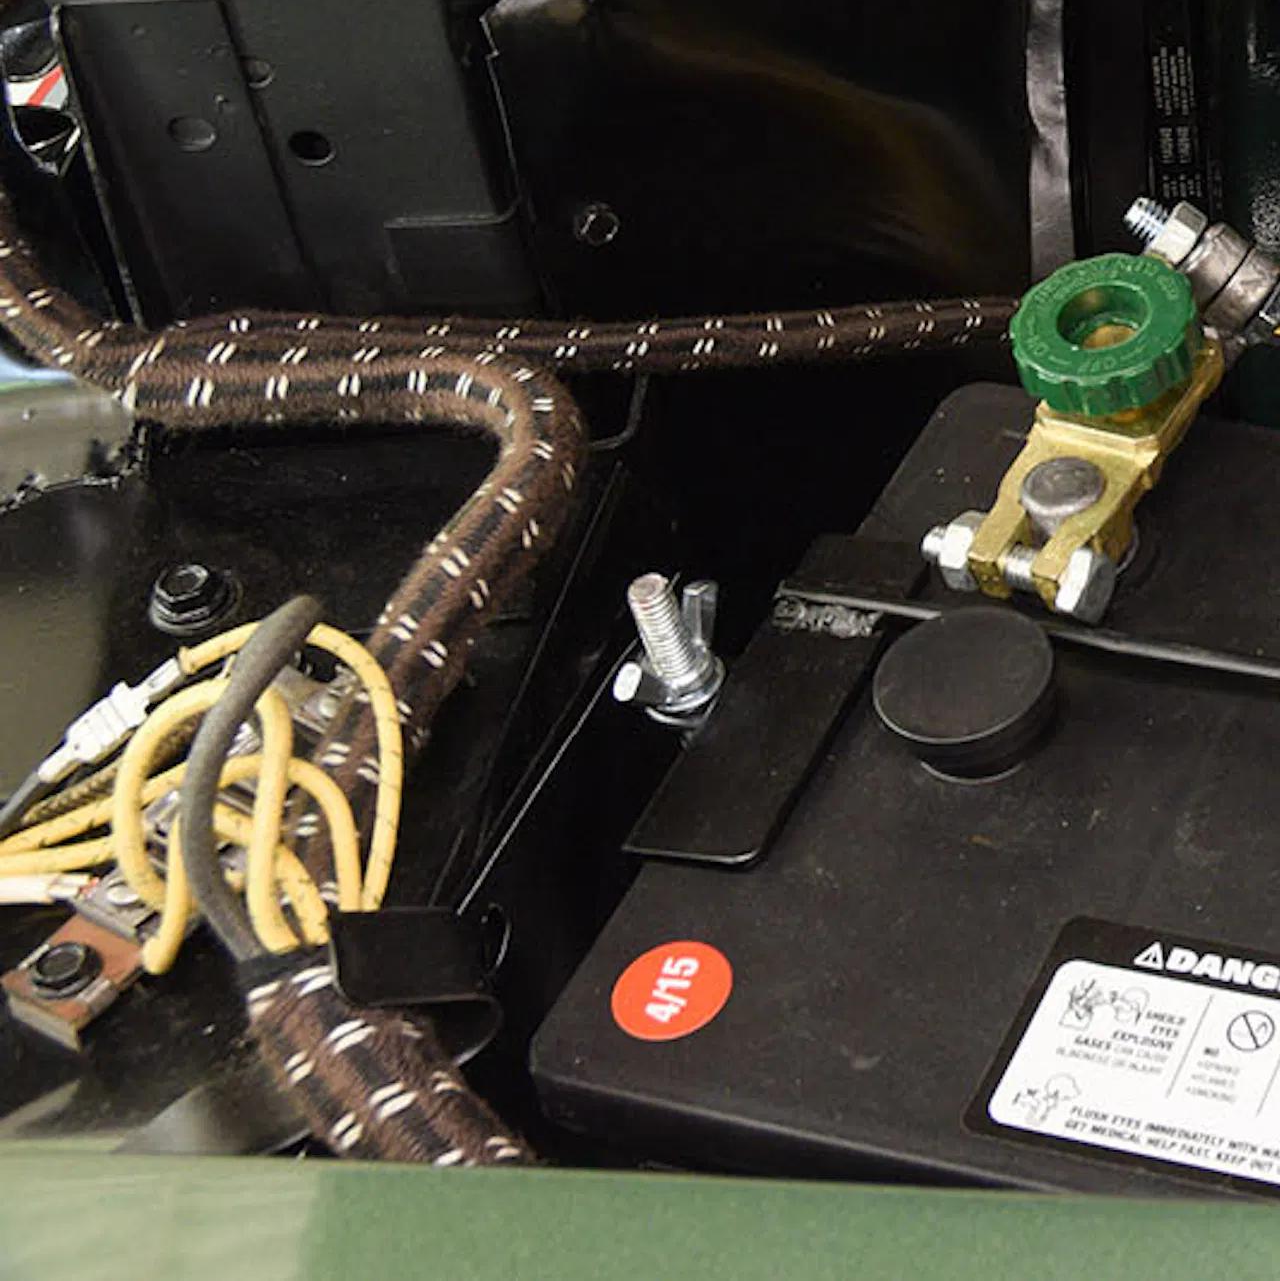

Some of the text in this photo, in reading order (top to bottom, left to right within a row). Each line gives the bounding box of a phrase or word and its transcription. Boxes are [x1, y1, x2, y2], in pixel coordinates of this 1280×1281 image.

[644, 956, 699, 1023] 4/15
[1112, 1029, 1173, 1051] EXPLOSIVE
[1150, 1024, 1180, 1038] EYES
[1064, 1118, 1088, 1131] GET
[1091, 1124, 1141, 1144] MEDICAL
[1146, 1137, 1178, 1149] HELP
[1215, 1151, 1248, 1165] KEEP
[1249, 1159, 1274, 1172] OUT
[1070, 1105, 1109, 1122] FLUSH
[1110, 1114, 1142, 1129] EYES
[1144, 1122, 1225, 1147] IMMEDIATELY
[1227, 1139, 1258, 1154] WITH
